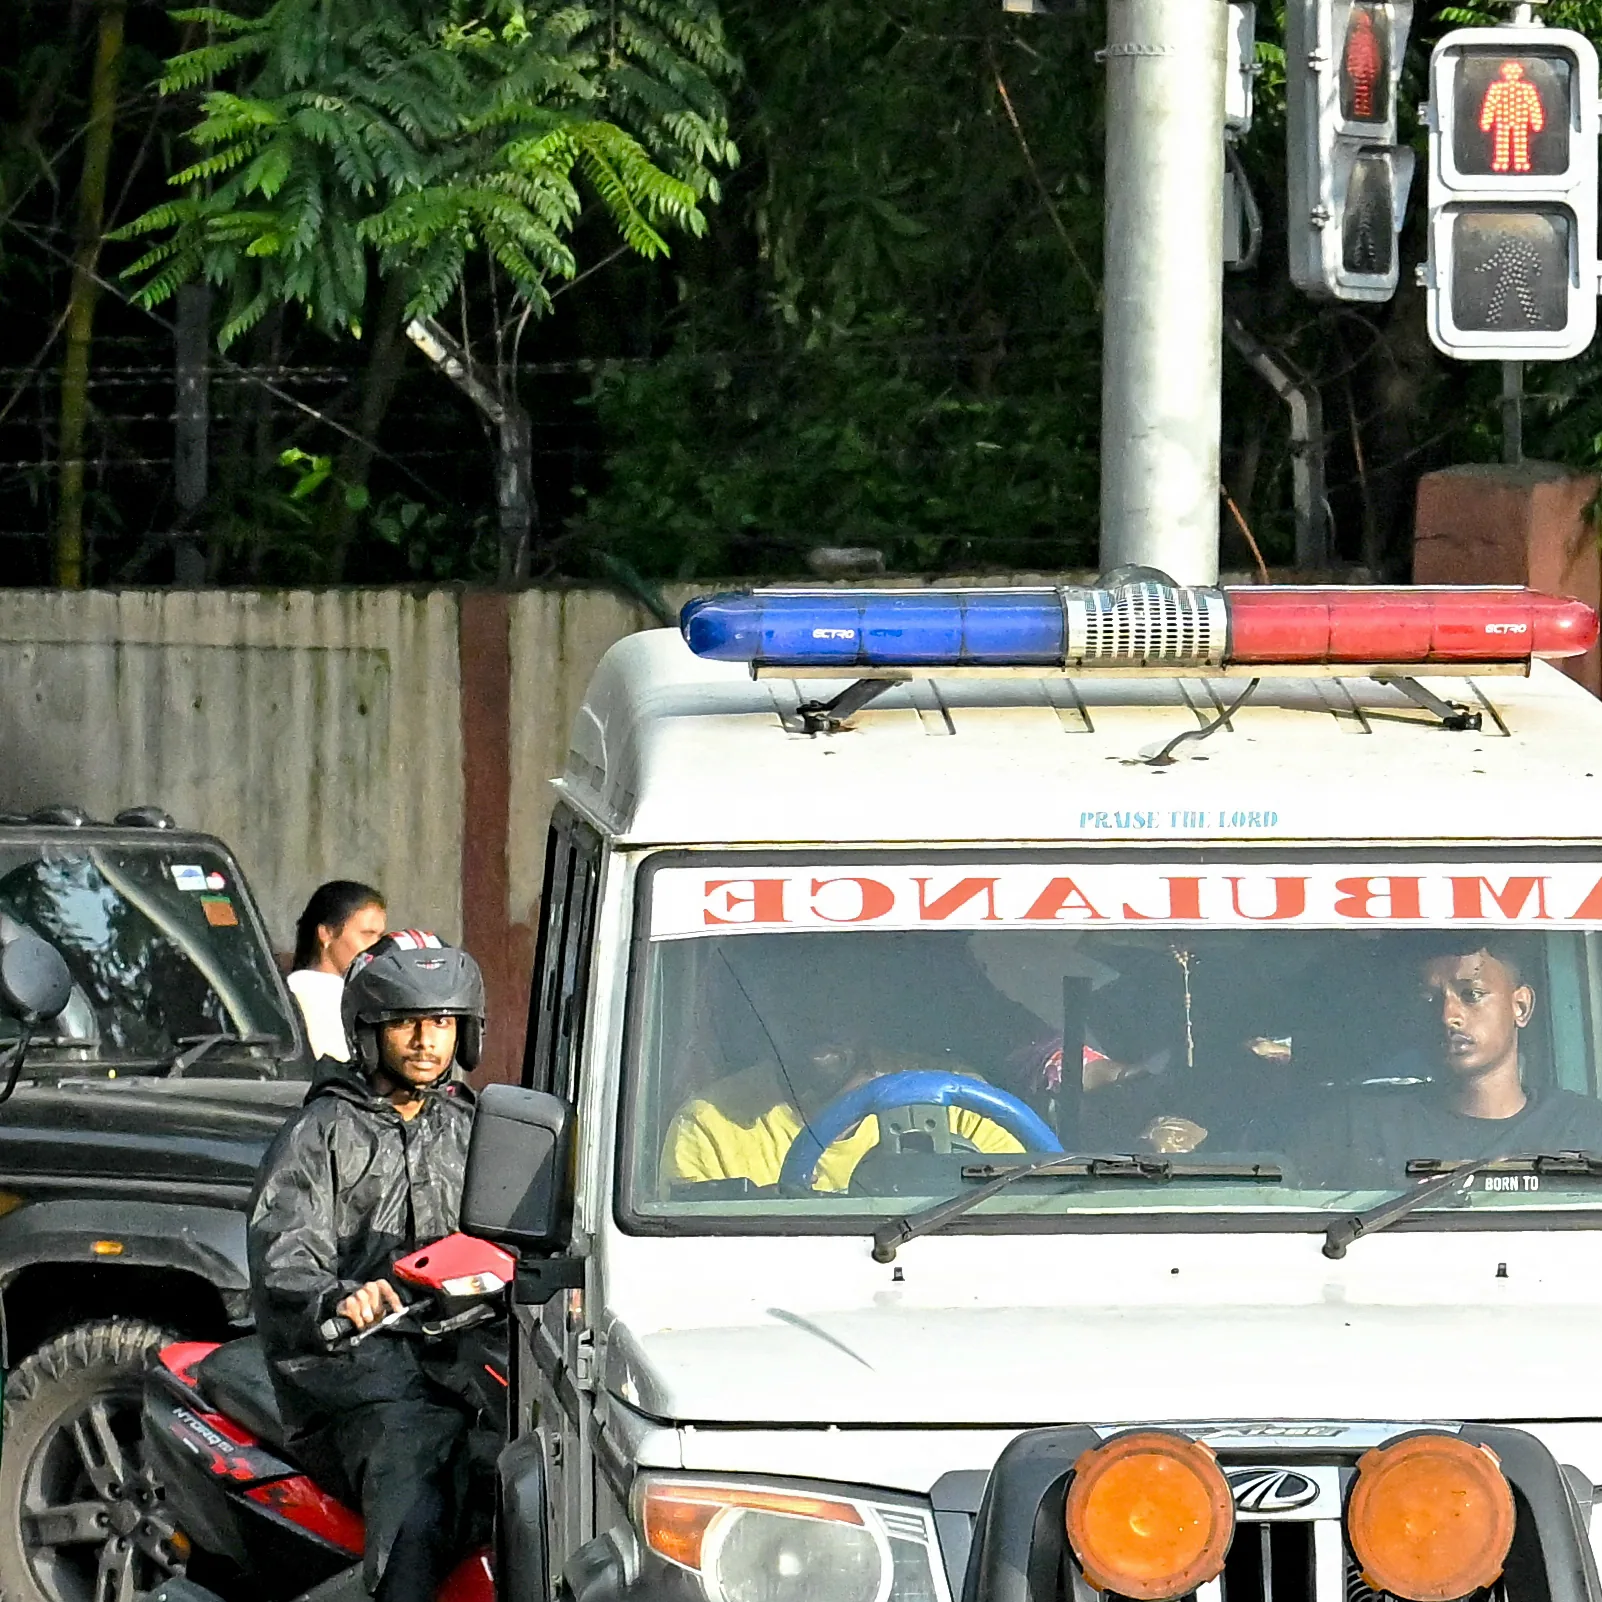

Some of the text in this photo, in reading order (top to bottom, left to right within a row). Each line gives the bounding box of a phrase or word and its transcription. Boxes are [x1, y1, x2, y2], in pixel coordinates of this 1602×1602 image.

[1079, 810, 1278, 829] PRAISE THE LORD
[1485, 1175, 1539, 1191] BORN TO
